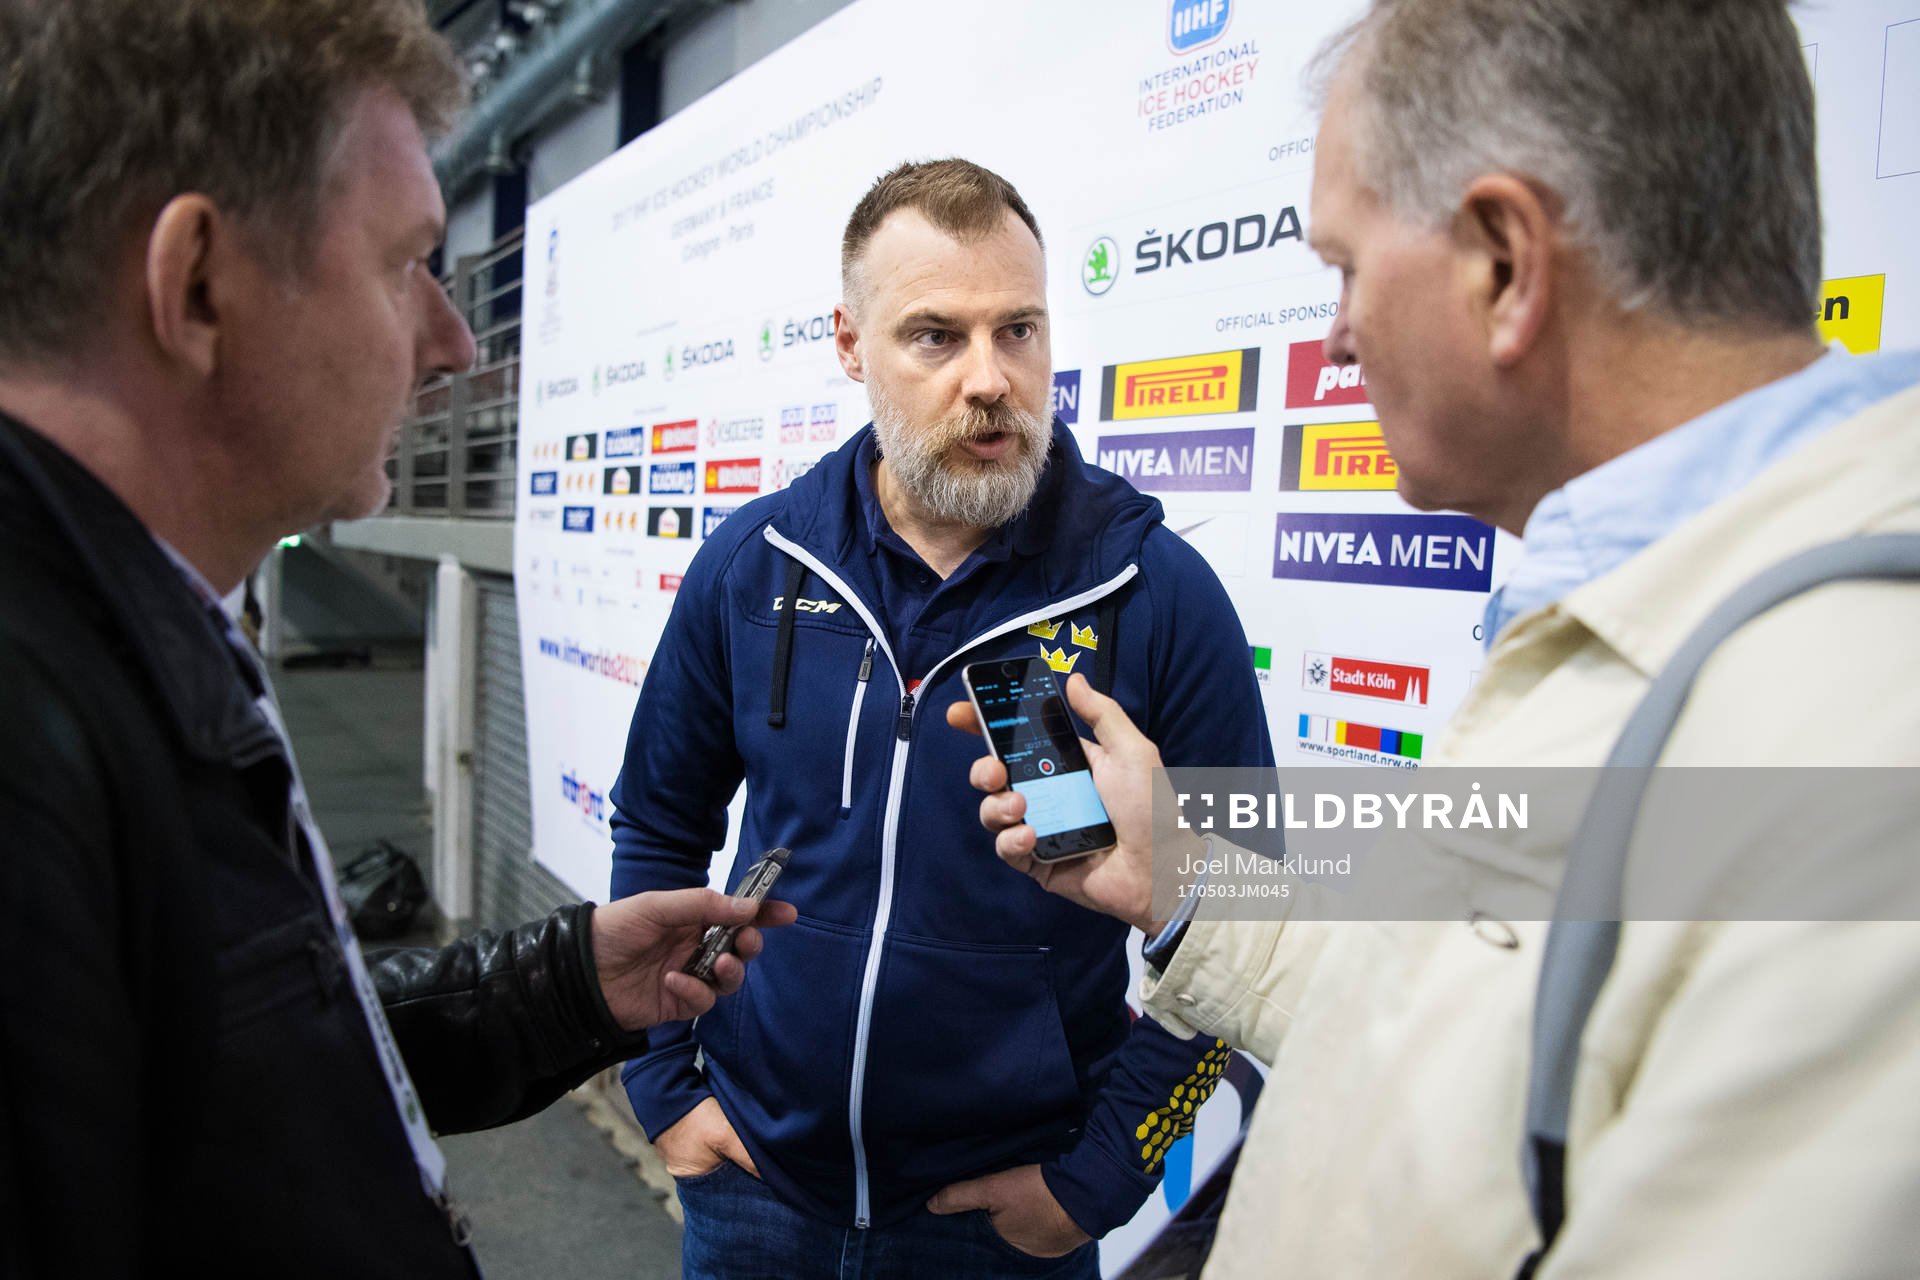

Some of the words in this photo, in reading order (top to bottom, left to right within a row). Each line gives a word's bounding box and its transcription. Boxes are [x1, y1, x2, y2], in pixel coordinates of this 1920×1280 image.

[1174, 0, 1225, 37] IIHF
[1139, 40, 1259, 94] INTERNATIONAL
[1138, 91, 1167, 117] ICE
[1174, 58, 1258, 105] HOCKEY
[717, 139, 763, 178] WORLD
[765, 76, 883, 156] CHAMPIONSHIP
[1148, 89, 1243, 133] FEDERATION
[1269, 136, 1317, 161] OFFICI
[729, 176, 775, 211] FRANCE
[1135, 205, 1304, 274] ŠKODA
[1216, 311, 1274, 332] OFFICIAL
[682, 338, 735, 370] ŠKODA
[1124, 365, 1228, 407] PIRELLI
[1099, 447, 1174, 477] NIVEA
[1178, 445, 1249, 475] MEN
[1279, 529, 1382, 566] NIVEA
[1390, 534, 1487, 571] MEN
[1332, 668, 1365, 687] Stadt
[1367, 672, 1396, 690] Köln
[1299, 741, 1419, 771] www.sportland.nrw.de
